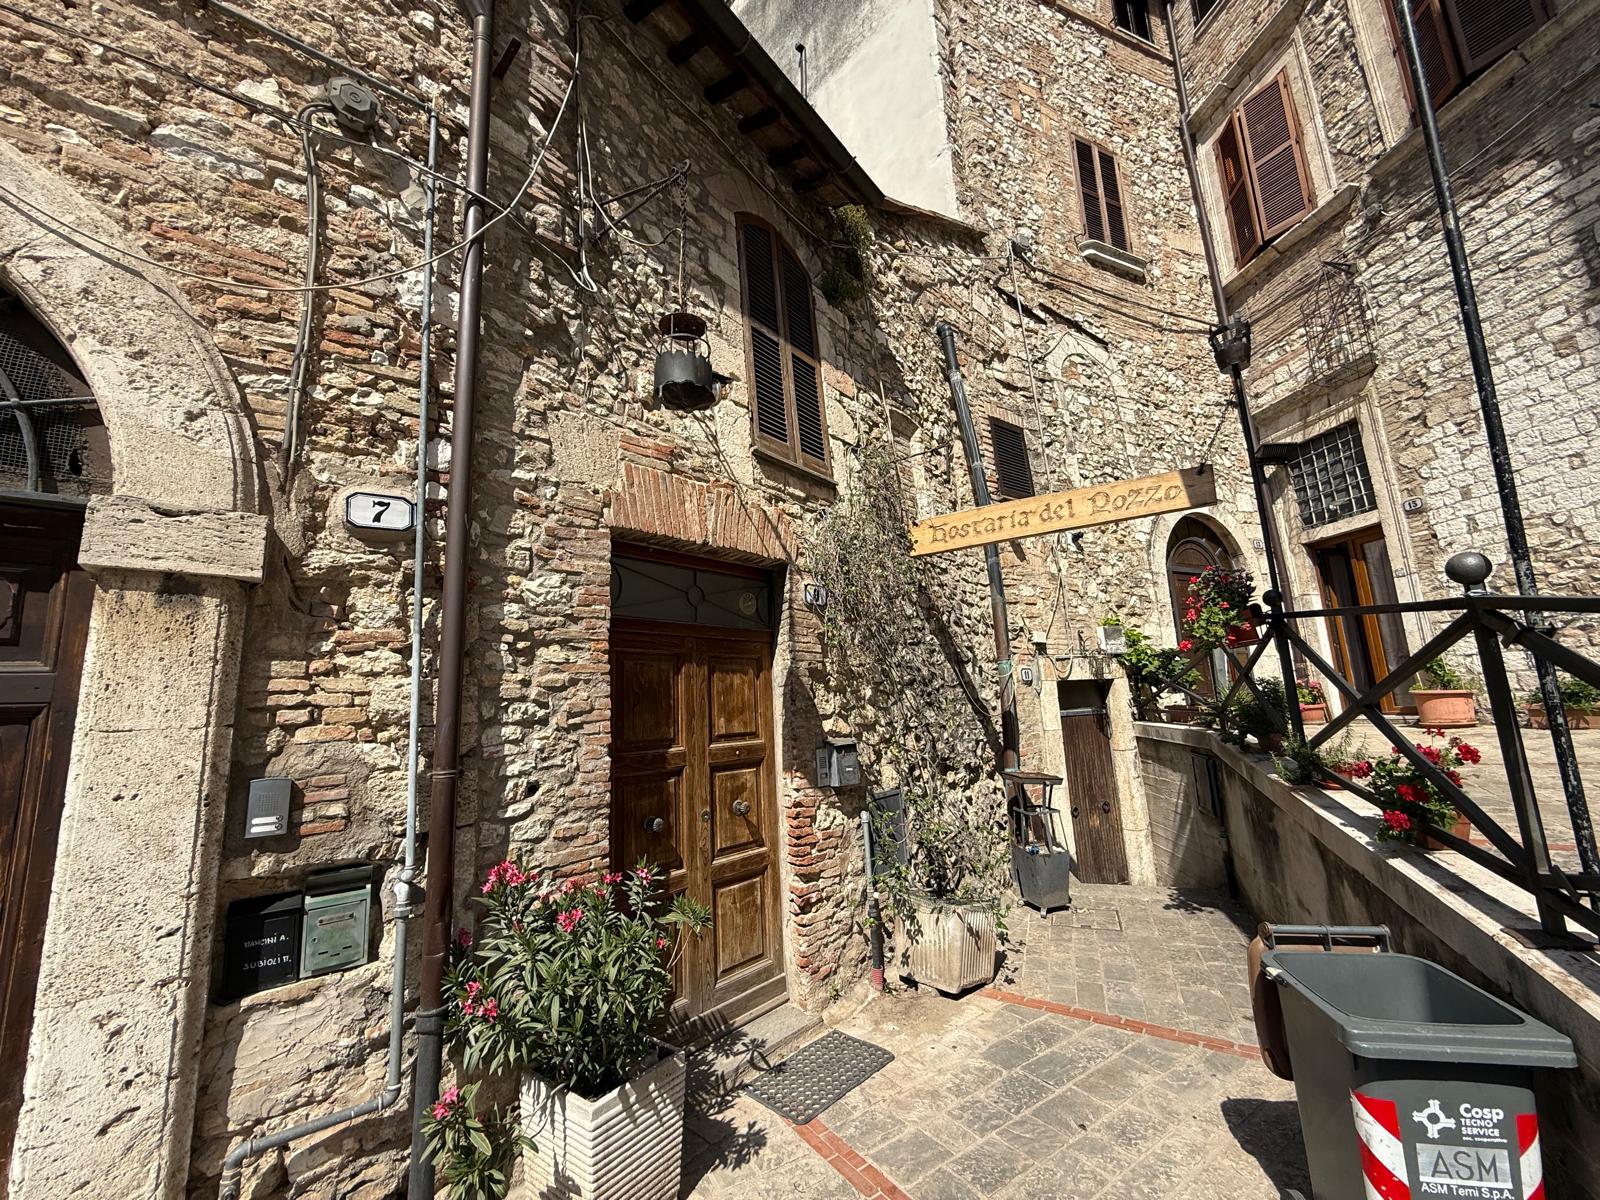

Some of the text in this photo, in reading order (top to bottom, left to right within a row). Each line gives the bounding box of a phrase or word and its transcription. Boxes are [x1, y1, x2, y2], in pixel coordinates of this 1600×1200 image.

[372, 500, 391, 523] 7
[1039, 498, 1076, 523] del
[1459, 1103, 1504, 1123] Cosp
[1460, 1118, 1493, 1127] TECNO
[1461, 1127, 1500, 1137] SERVICE
[1431, 1150, 1499, 1183] ASM
[1421, 1182, 1448, 1195] ASM
[1481, 1187, 1515, 1200] S.p.A.
